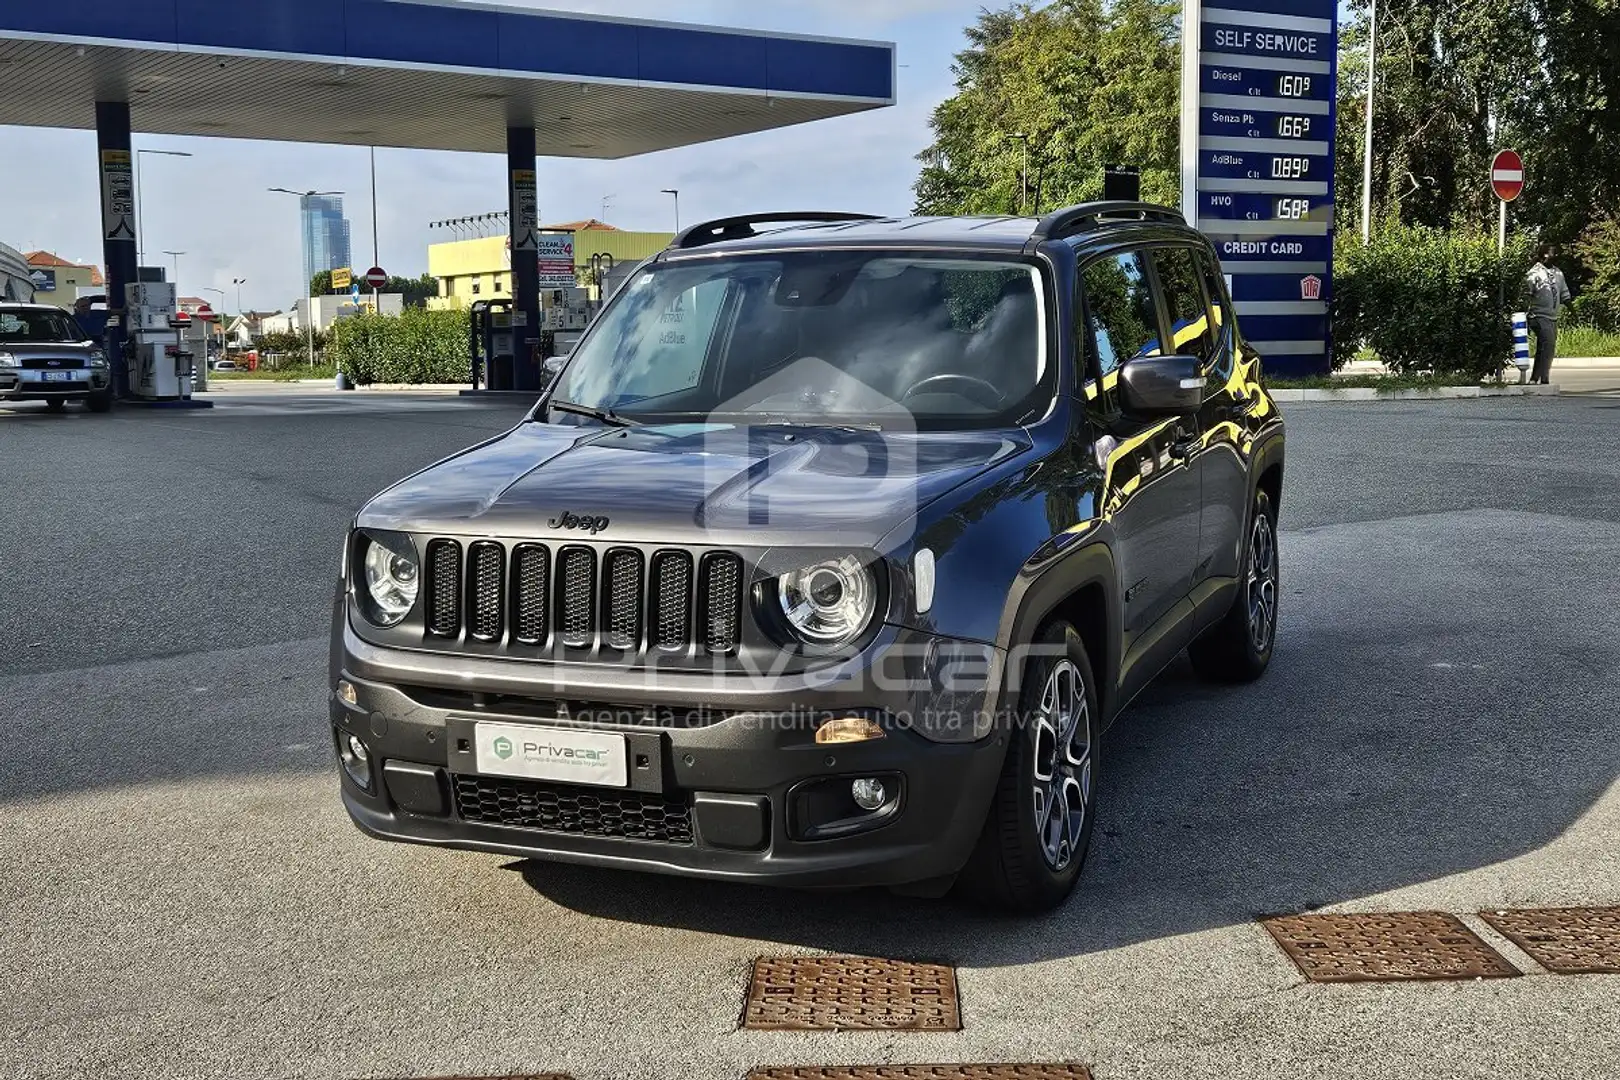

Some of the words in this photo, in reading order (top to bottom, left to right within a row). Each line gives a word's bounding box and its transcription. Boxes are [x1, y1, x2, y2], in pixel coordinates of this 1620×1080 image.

[1215, 29, 1252, 48] SELF
[1255, 33, 1317, 53] SERVICE
[1212, 70, 1242, 81] Diesel
[1212, 112, 1240, 123] Senza
[1243, 114, 1255, 124] Pb
[1212, 154, 1243, 165] AdBlue
[1211, 196, 1232, 206] HVO
[1223, 242, 1267, 254] CREDIT
[1270, 242, 1303, 254] CARD
[547, 511, 609, 535] Jeep
[523, 742, 610, 760] Privacar
